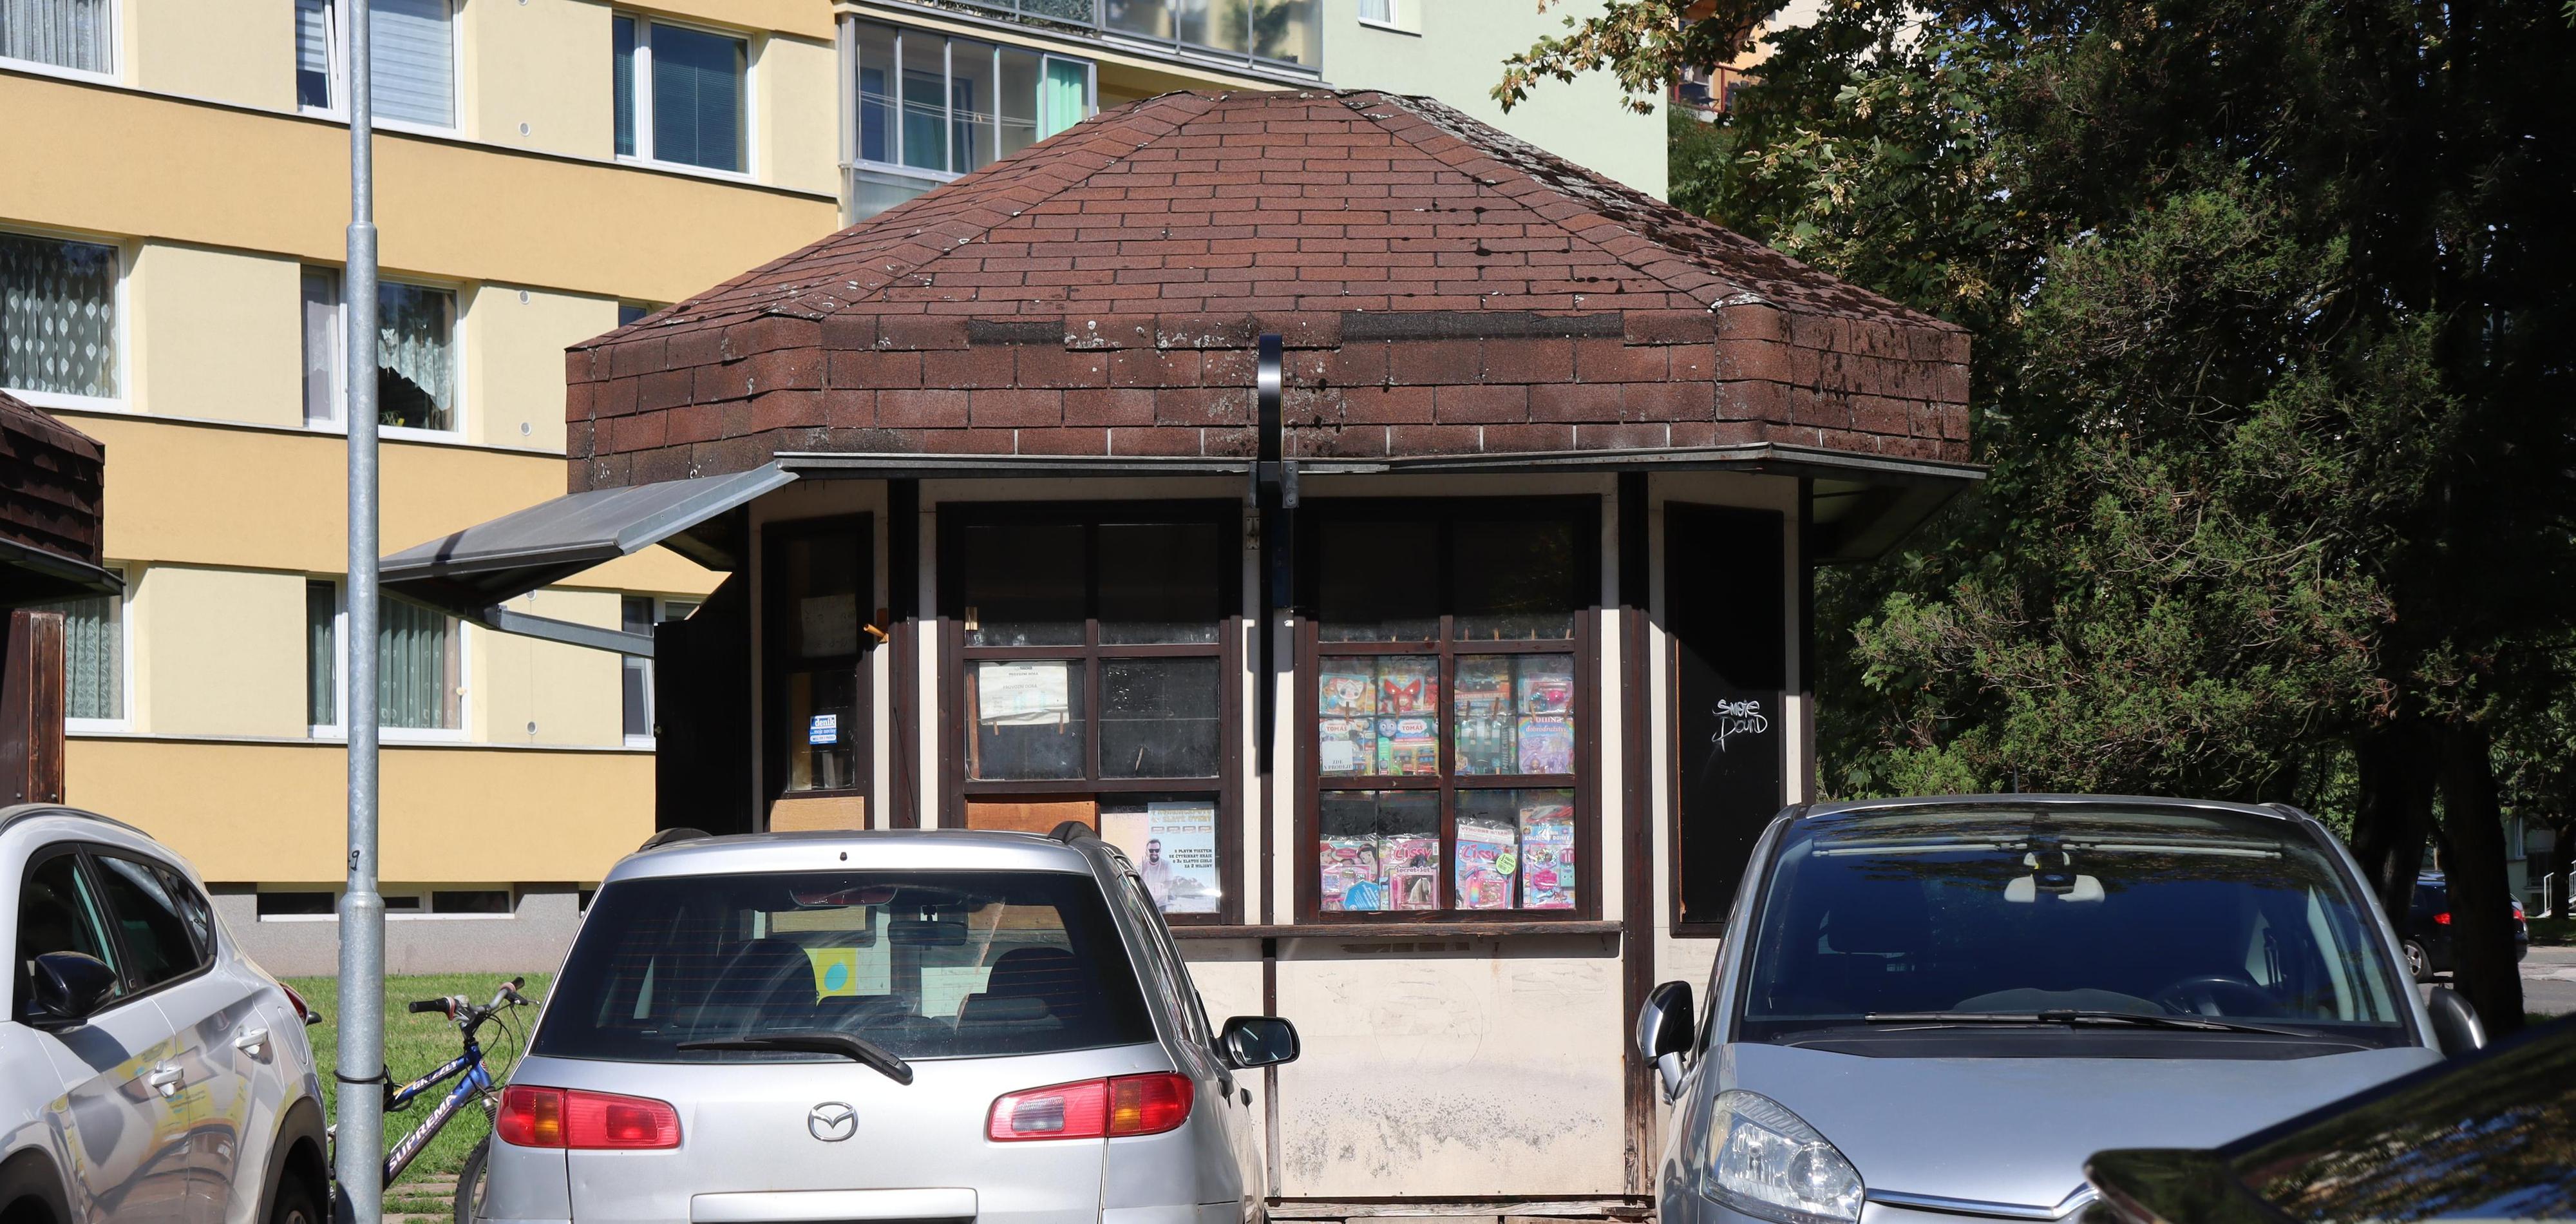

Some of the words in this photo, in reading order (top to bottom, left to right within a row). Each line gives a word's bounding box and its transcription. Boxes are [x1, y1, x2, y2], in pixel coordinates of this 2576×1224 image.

[815, 718, 835, 727] deník
[1501, 725, 1510, 770] MINECRAFT
[390, 1095, 457, 1172] SUPREMA
